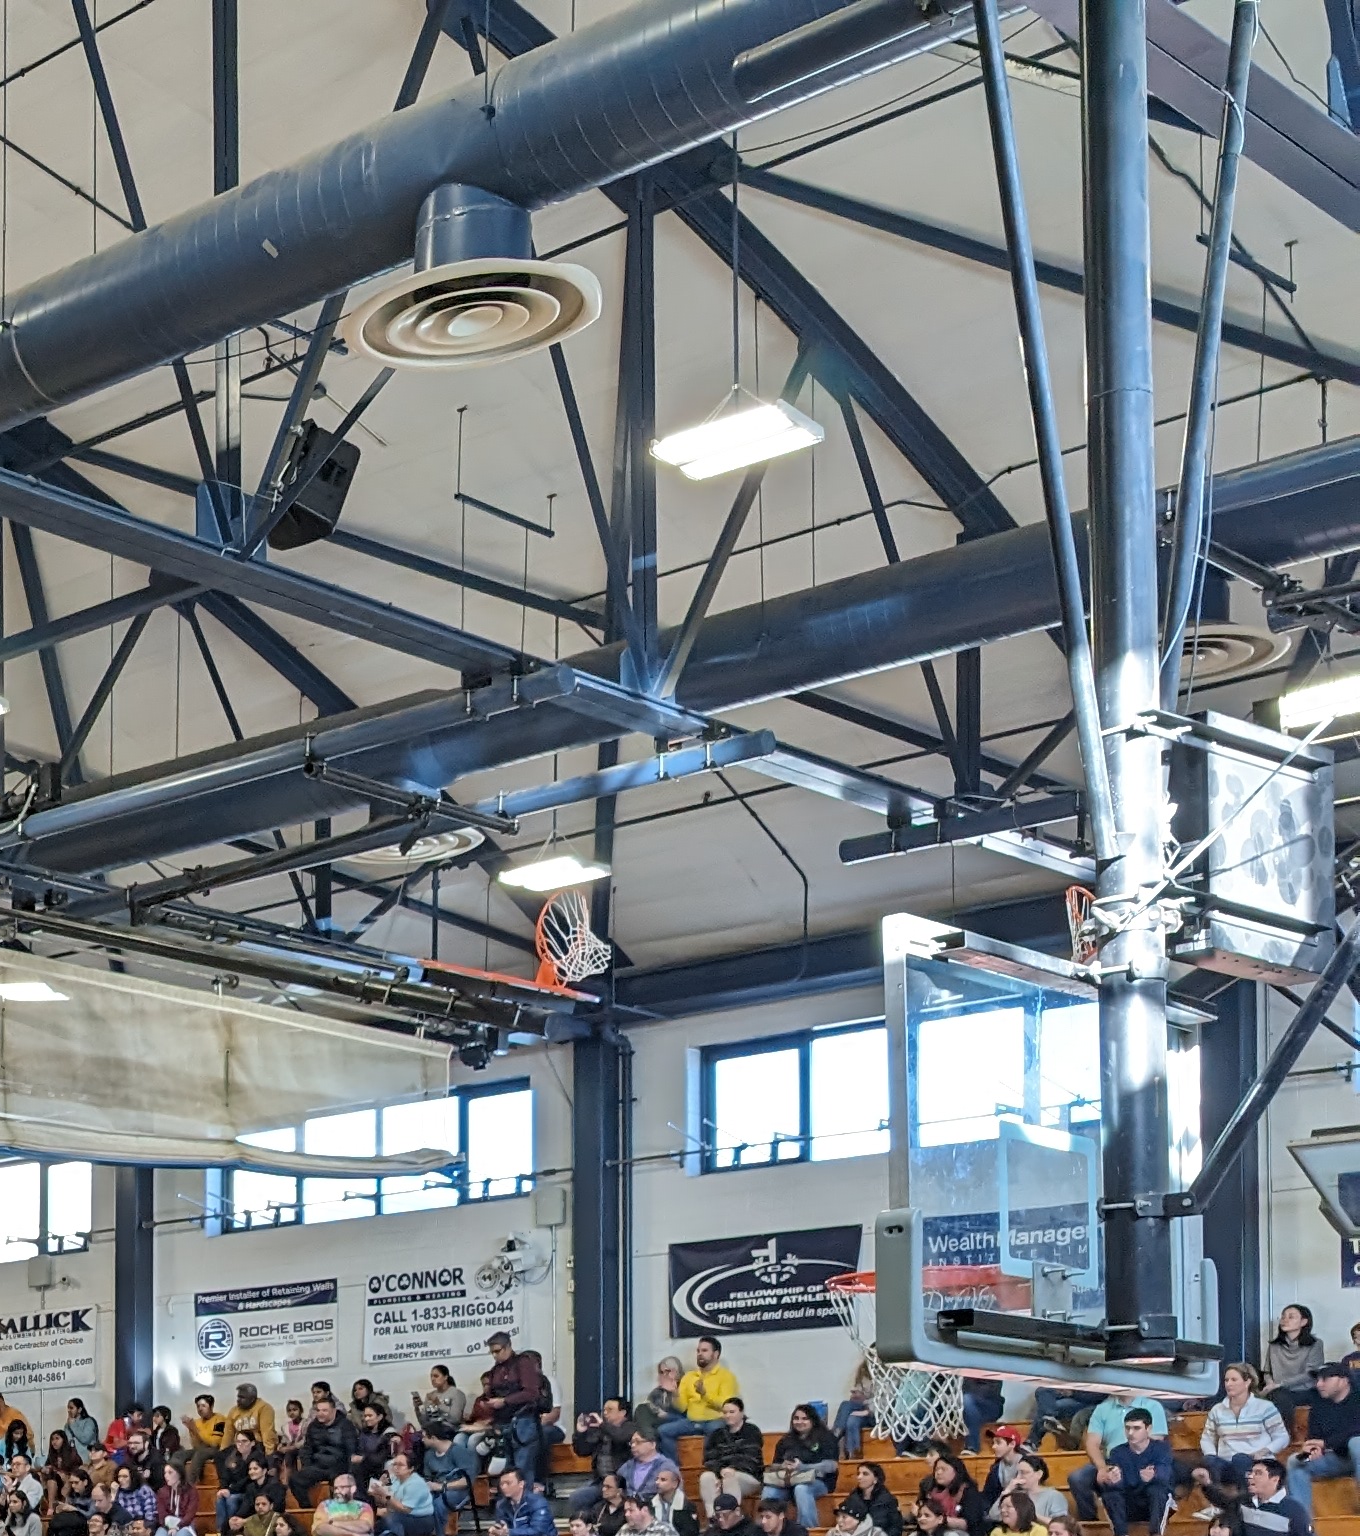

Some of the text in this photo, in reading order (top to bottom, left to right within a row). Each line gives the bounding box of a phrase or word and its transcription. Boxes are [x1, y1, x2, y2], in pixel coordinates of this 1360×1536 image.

[369, 1267, 465, 1293] O'CONNOR
[426, 1291, 461, 1299] HEATING
[730, 1286, 804, 1299] FELLOWSHIP
[704, 1297, 777, 1311] CHRISTIAN
[374, 1300, 513, 1324] CALL 1-833-RIGGO44
[718, 1307, 815, 1324] The heart and soul in
[240, 1319, 334, 1338] ROCHE BROS
[374, 1316, 514, 1336] FOR ALL YOUR PLUMBING NEEDS
[15, 1341, 49, 1350] Contractor
[467, 1342, 481, 1353] GO
[373, 1349, 451, 1361] EMERGENCY SERVICE
[5, 1372, 66, 1387] (301) 840-5861
